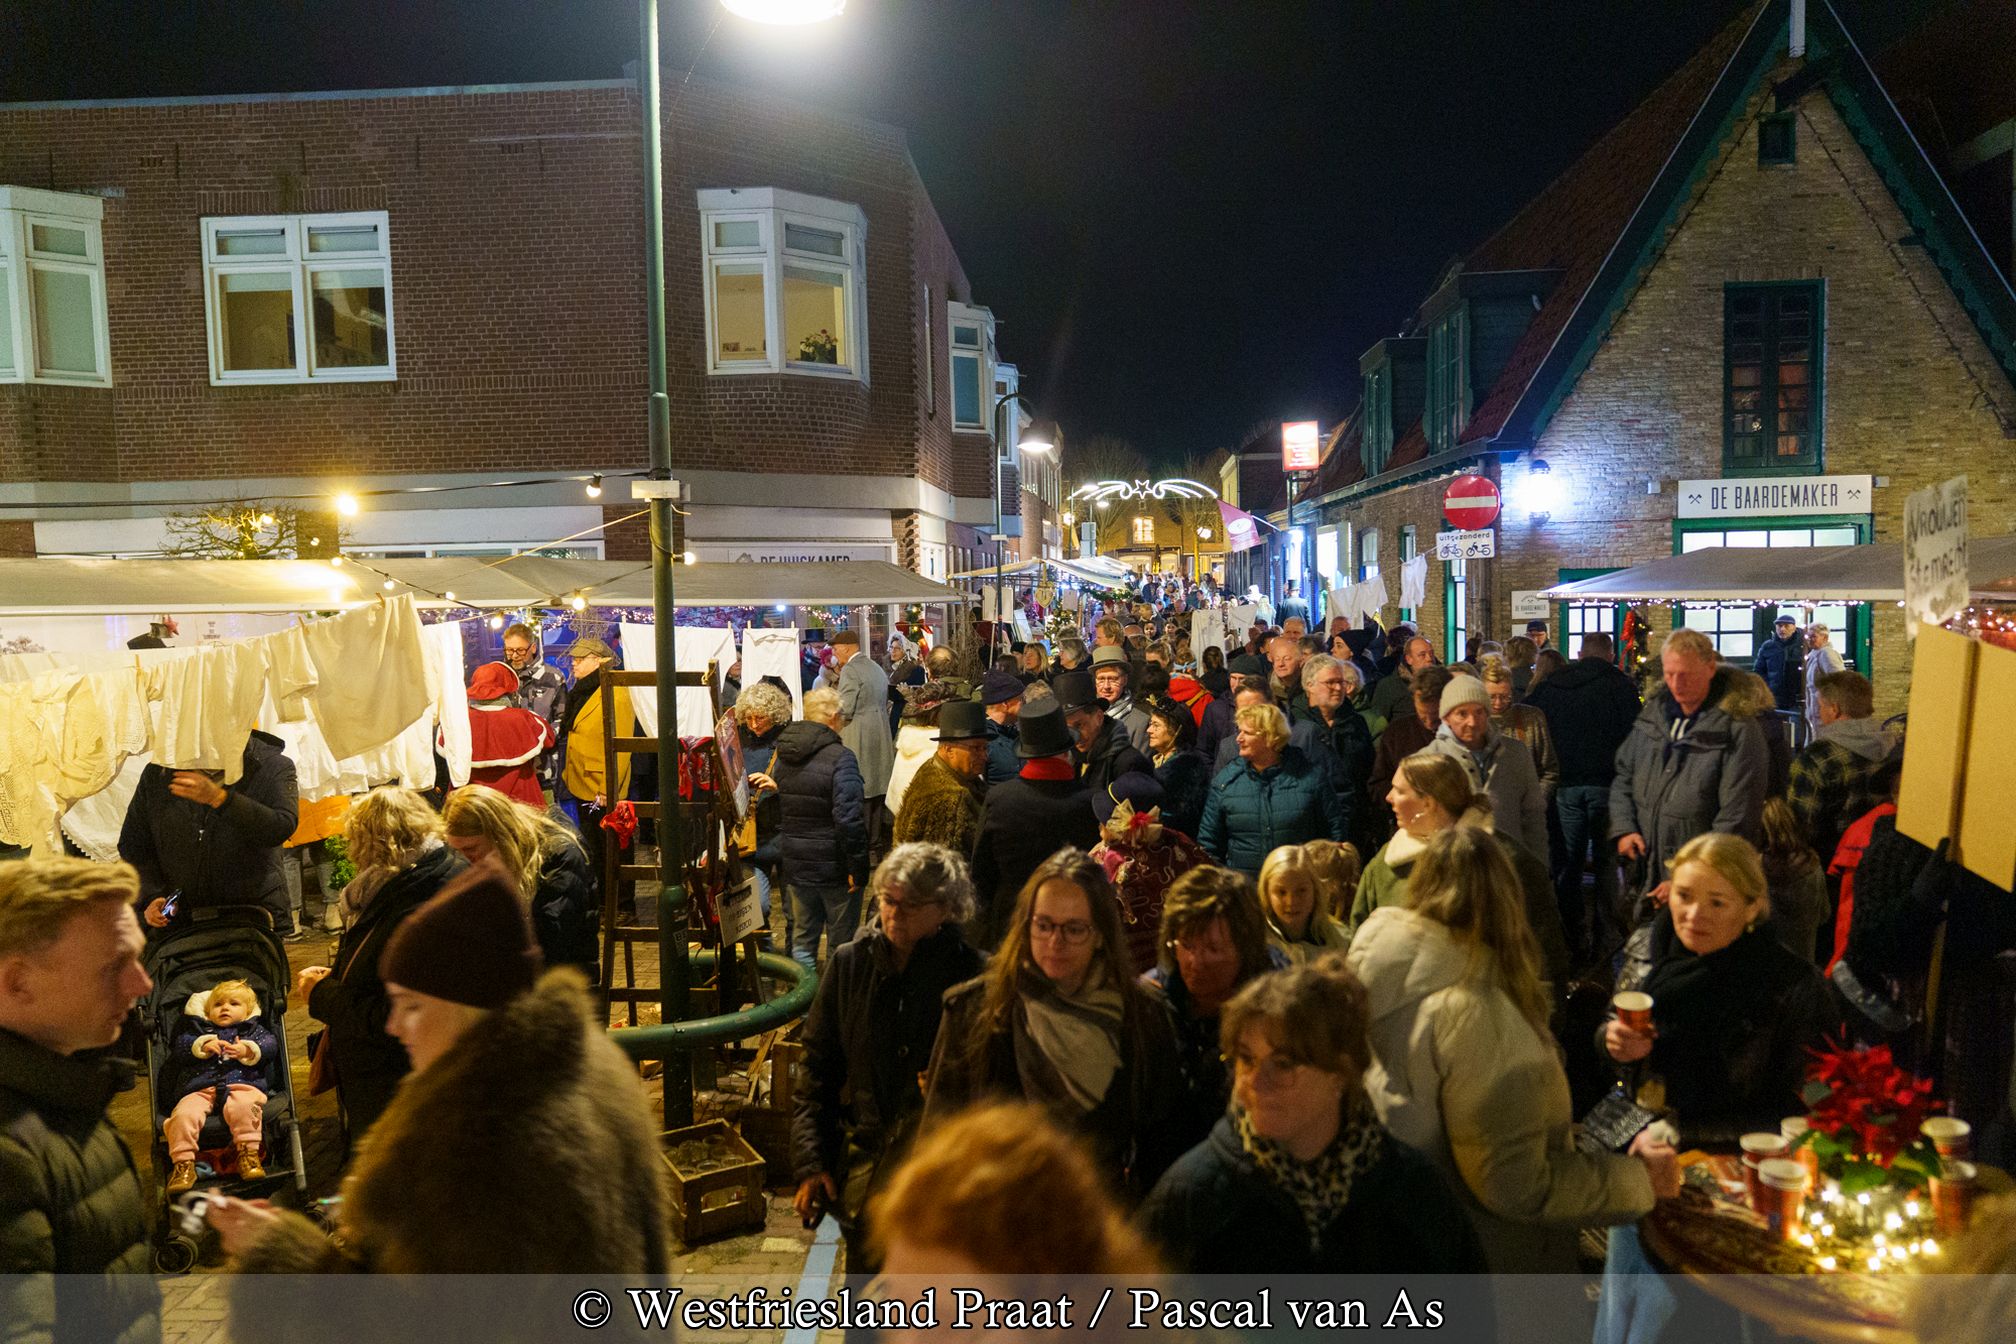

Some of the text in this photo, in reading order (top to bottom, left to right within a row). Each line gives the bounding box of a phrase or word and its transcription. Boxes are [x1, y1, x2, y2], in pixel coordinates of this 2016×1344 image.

[1711, 483, 1838, 510] DE BAARDEMAKER
[1440, 532, 1490, 541] uitgezonderd
